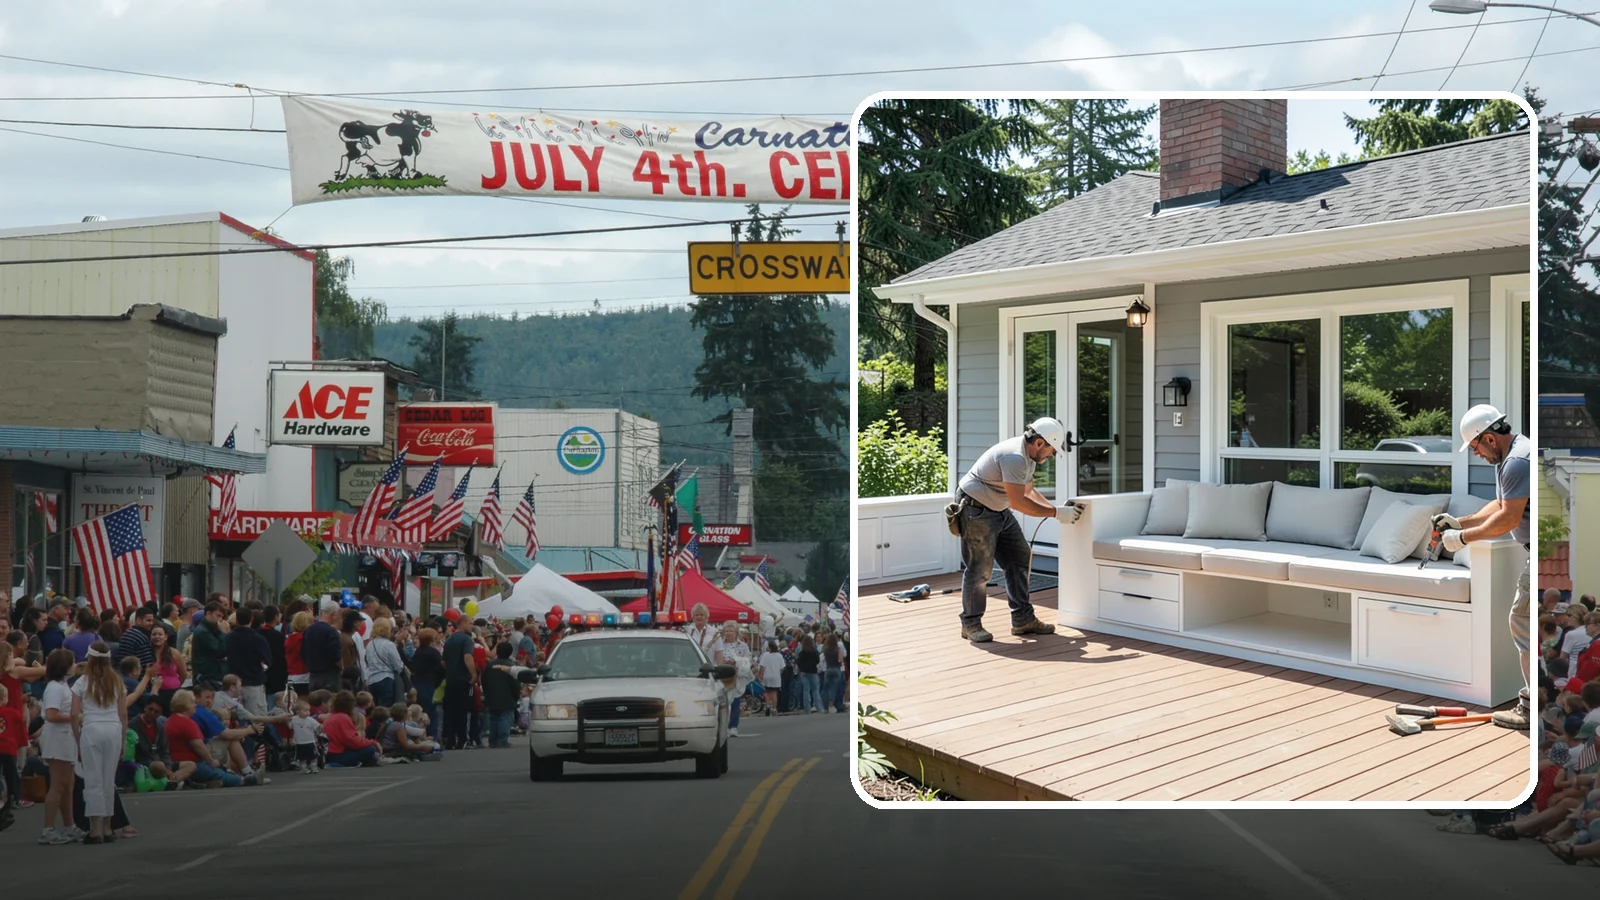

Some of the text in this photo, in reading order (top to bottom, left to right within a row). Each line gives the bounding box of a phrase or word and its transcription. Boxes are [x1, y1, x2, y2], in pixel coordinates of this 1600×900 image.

[481, 141, 605, 192] JULY
[632, 150, 746, 198] 4th.
[696, 254, 850, 280] CROSSWA
[283, 380, 373, 420] ACE
[405, 409, 485, 422] CEDAR LOG
[284, 421, 371, 436] Hardware
[416, 428, 477, 447] Coca-Cola
[353, 466, 385, 481] Simpl
[83, 485, 155, 495] St. Vincent de Paul
[688, 526, 742, 535] CRNATION
[698, 535, 730, 543] GLASS
